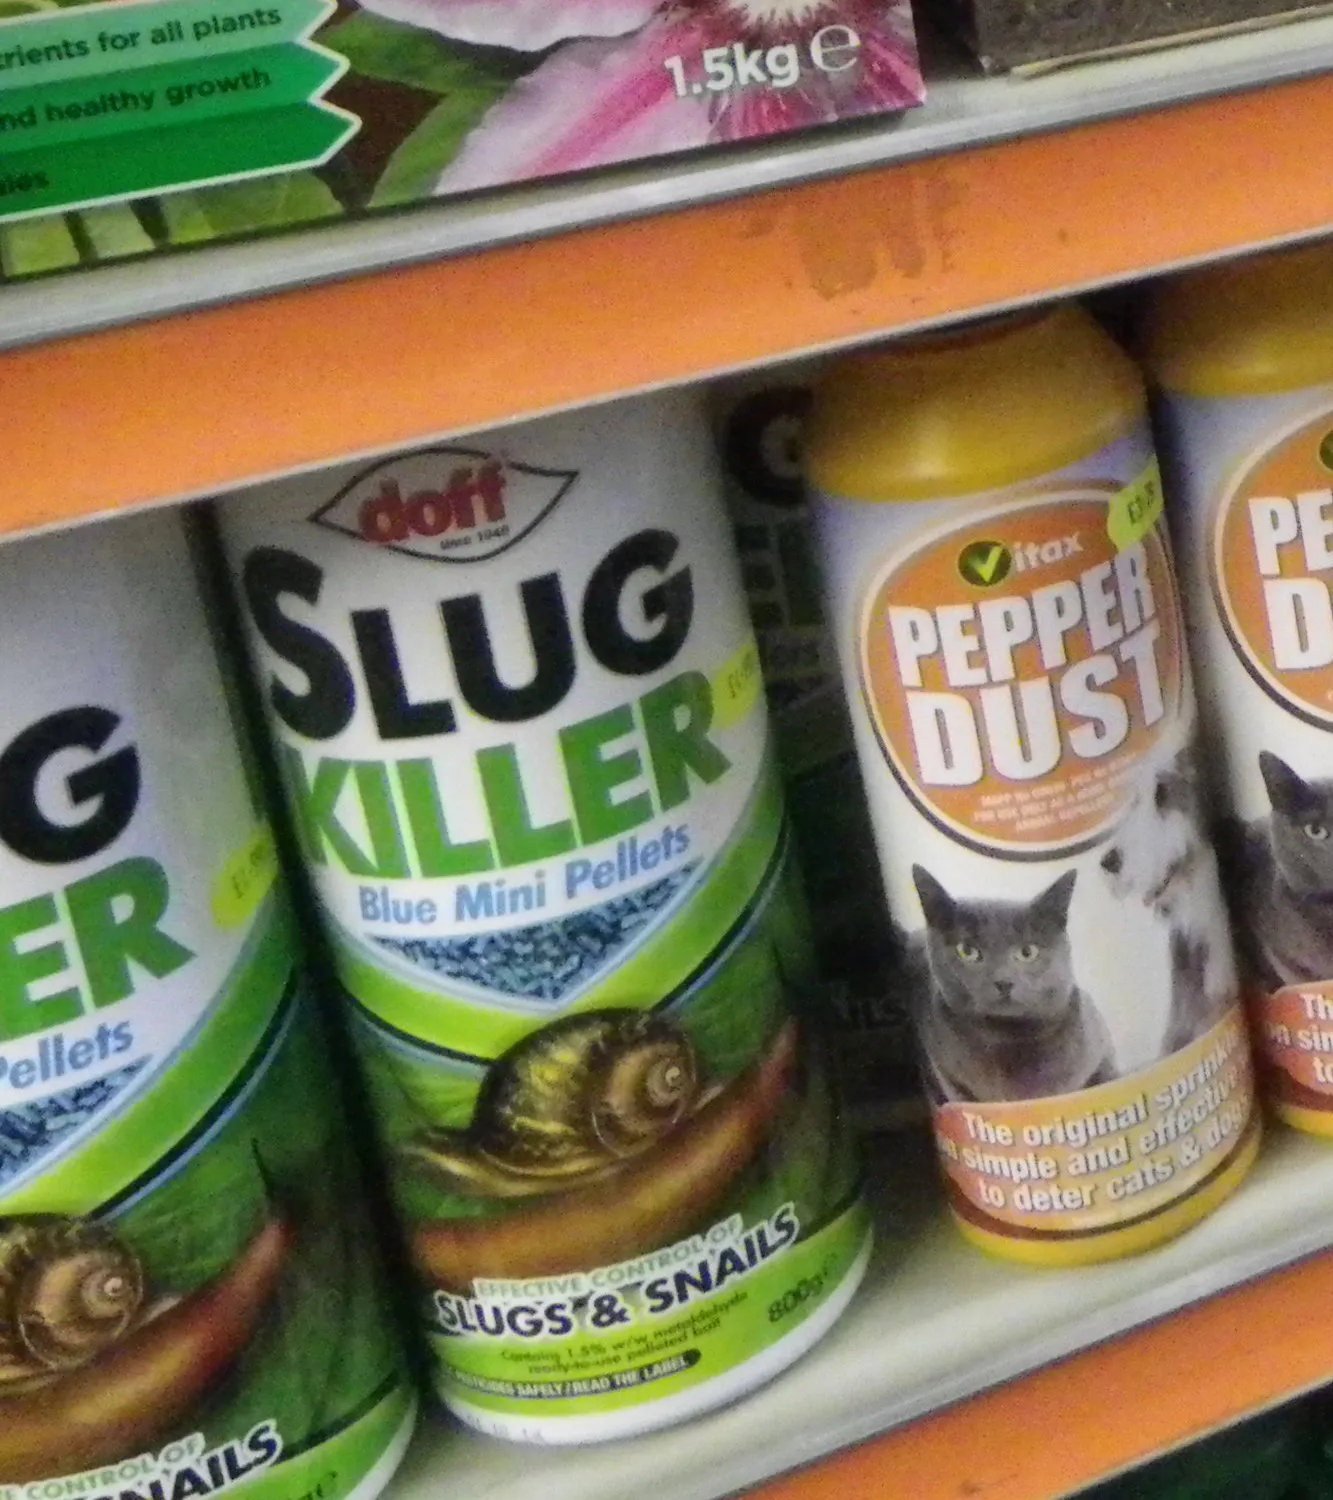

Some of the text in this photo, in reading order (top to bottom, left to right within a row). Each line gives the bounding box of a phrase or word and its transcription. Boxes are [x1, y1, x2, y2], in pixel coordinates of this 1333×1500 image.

[97, 4, 282, 53] for all plants
[43, 66, 272, 126] healthy growth
[663, 38, 801, 102] 1.5kg
[359, 461, 508, 545] doff
[968, 530, 1085, 586] Vitax
[241, 526, 696, 743] SLUG
[886, 542, 1156, 690] PEPPER
[904, 620, 1166, 787] DUST
[284, 668, 733, 881] KILLER
[357, 822, 692, 926] Blue Mini Pellets
[962, 1092, 1149, 1149] The original
[962, 1137, 1131, 1183] simple and
[978, 1155, 1176, 1214] to deter cats
[437, 1206, 797, 1338] SLUGS & SNAILS
[477, 1238, 702, 1299] EFFECTIVE CONTROL
[161, 1439, 202, 1464] OF
